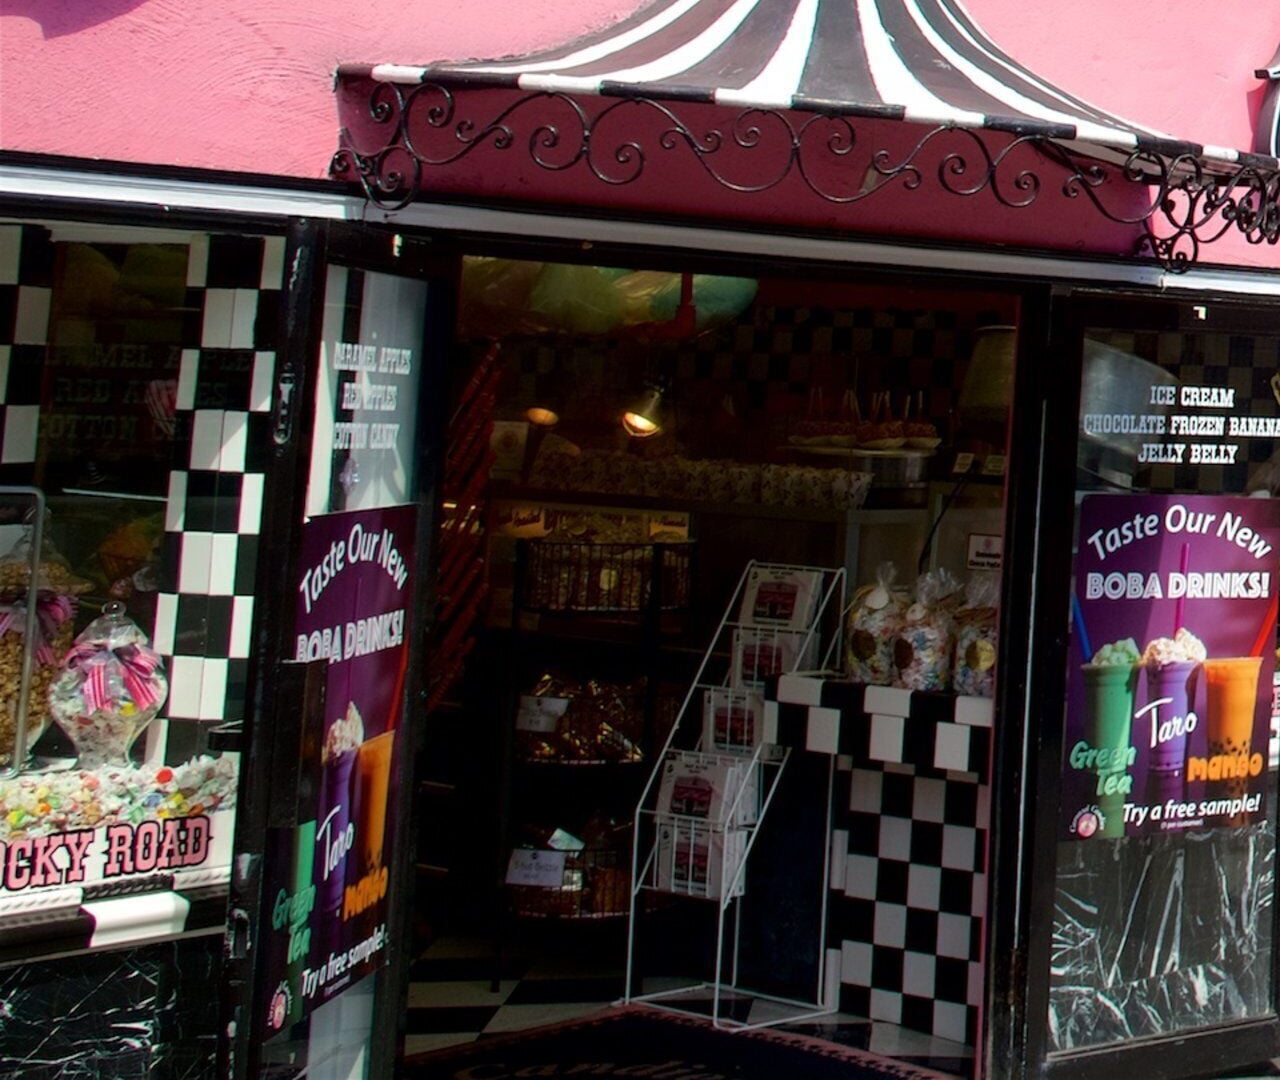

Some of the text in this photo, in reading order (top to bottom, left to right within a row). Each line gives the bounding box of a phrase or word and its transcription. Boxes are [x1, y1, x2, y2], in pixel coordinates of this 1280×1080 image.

[379, 347, 412, 375] APPLES
[1150, 386, 1235, 408] ICE CREAM
[1084, 414, 1166, 435] CHOCOLATE
[1170, 416, 1225, 436] FROZEN
[1137, 443, 1238, 464] JELLY BELLY
[1087, 504, 1272, 561] Taste Our New
[300, 522, 409, 613] Taste Our New
[1086, 572, 1271, 600] BOBA DRINKS!
[296, 610, 405, 664] BOBA DRINKS!
[1134, 697, 1198, 748] Taro
[1069, 740, 1137, 770] Green
[1095, 771, 1132, 796] Tea
[1122, 803, 1149, 825] Try
[1150, 807, 1161, 821] a
[1162, 800, 1198, 821] free
[1198, 793, 1261, 818] sample!
[103, 814, 214, 877] ROAD
[316, 805, 355, 881] Taro
[301, 966, 322, 998] Try
[327, 948, 348, 979] free
[345, 924, 387, 972] sample!
